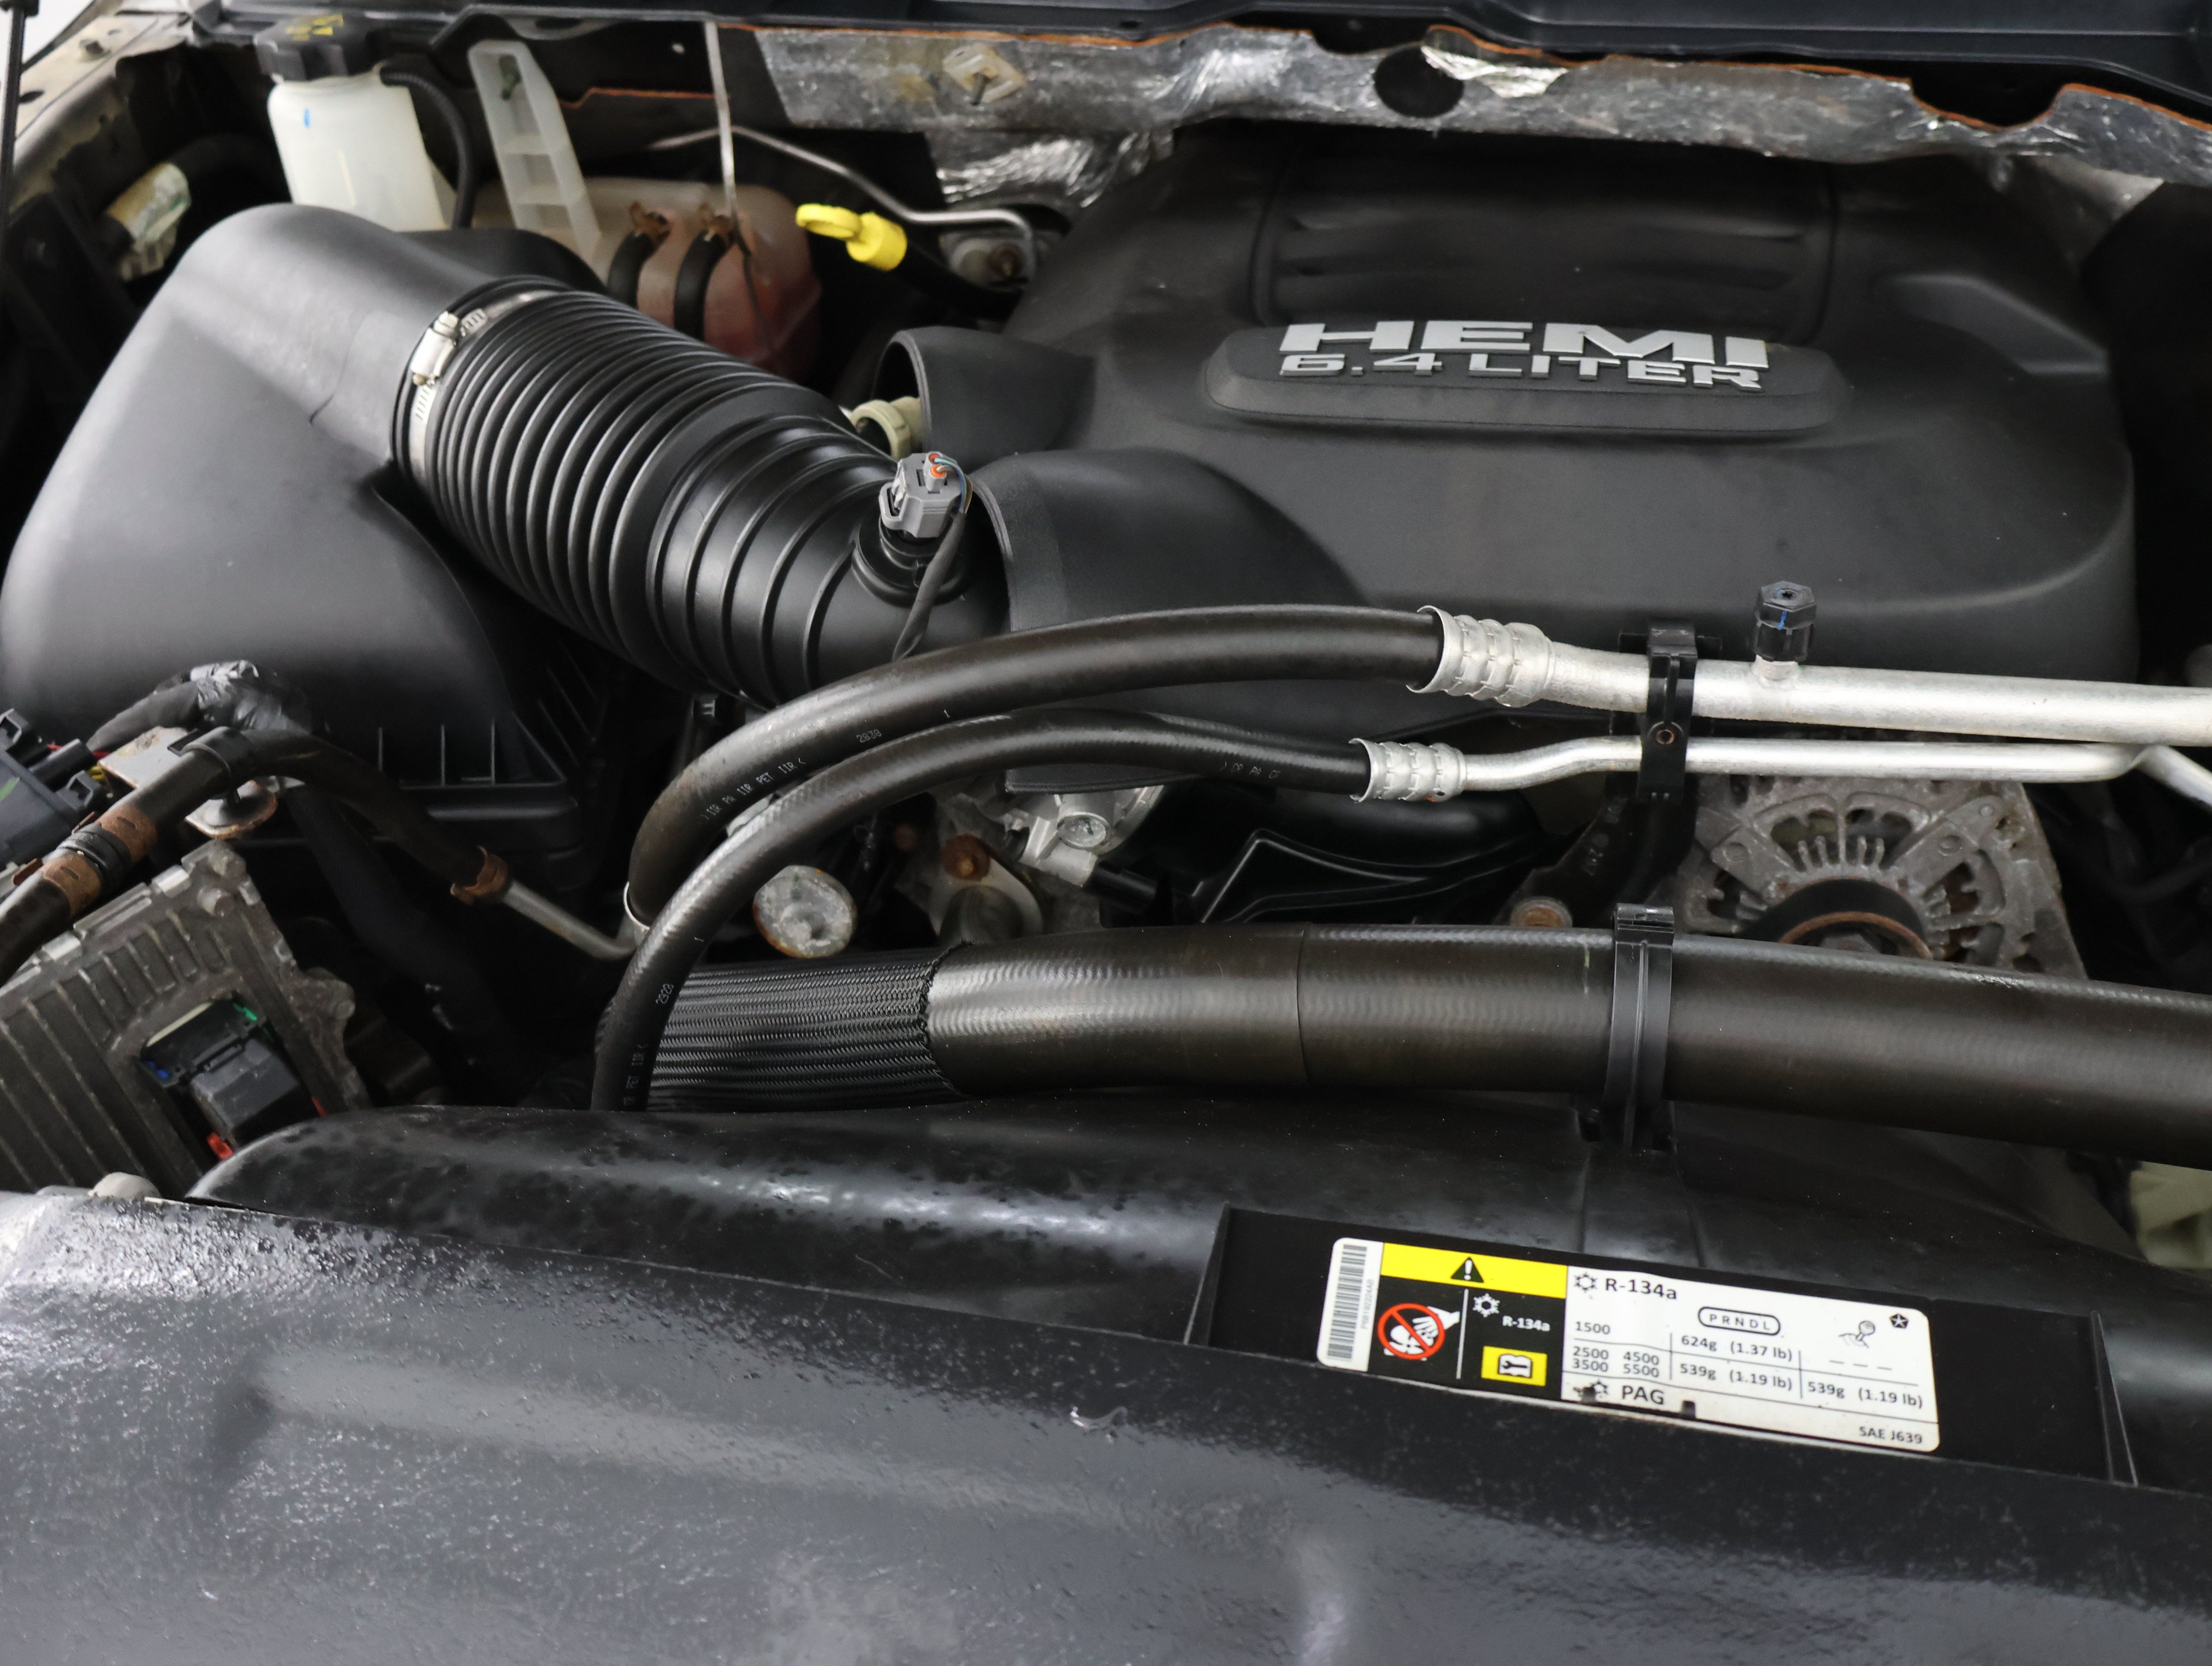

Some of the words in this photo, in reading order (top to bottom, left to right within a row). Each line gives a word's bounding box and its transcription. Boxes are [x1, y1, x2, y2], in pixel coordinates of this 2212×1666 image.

[1279, 320, 1768, 368] HEMI
[1279, 352, 1443, 376] 6.4
[1469, 353, 1762, 390] LITER
[756, 772, 773, 784] PET
[1605, 1278, 1677, 1300] R-134a
[1502, 1315, 1551, 1332] R-134a
[1575, 1321, 1610, 1335] 1500
[1573, 1346, 1609, 1360] 2500
[1623, 1351, 1659, 1366] 4500
[1681, 1335, 1717, 1352] 624g
[1731, 1341, 1768, 1356] (1.37
[1773, 1347, 1792, 1362] lb)
[1572, 1358, 1609, 1372] 3500
[1623, 1363, 1659, 1378] 5500
[1680, 1363, 1716, 1381] 539g
[1729, 1369, 1767, 1385] (1.19
[1773, 1376, 1792, 1391] lb)
[1622, 1385, 1664, 1405] PAG
[1808, 1381, 1845, 1399] 539g
[1858, 1387, 1897, 1403] (1.19
[1903, 1393, 1923, 1409] lb)
[1859, 1426, 1885, 1440] SAE
[1890, 1430, 1923, 1444] J639
